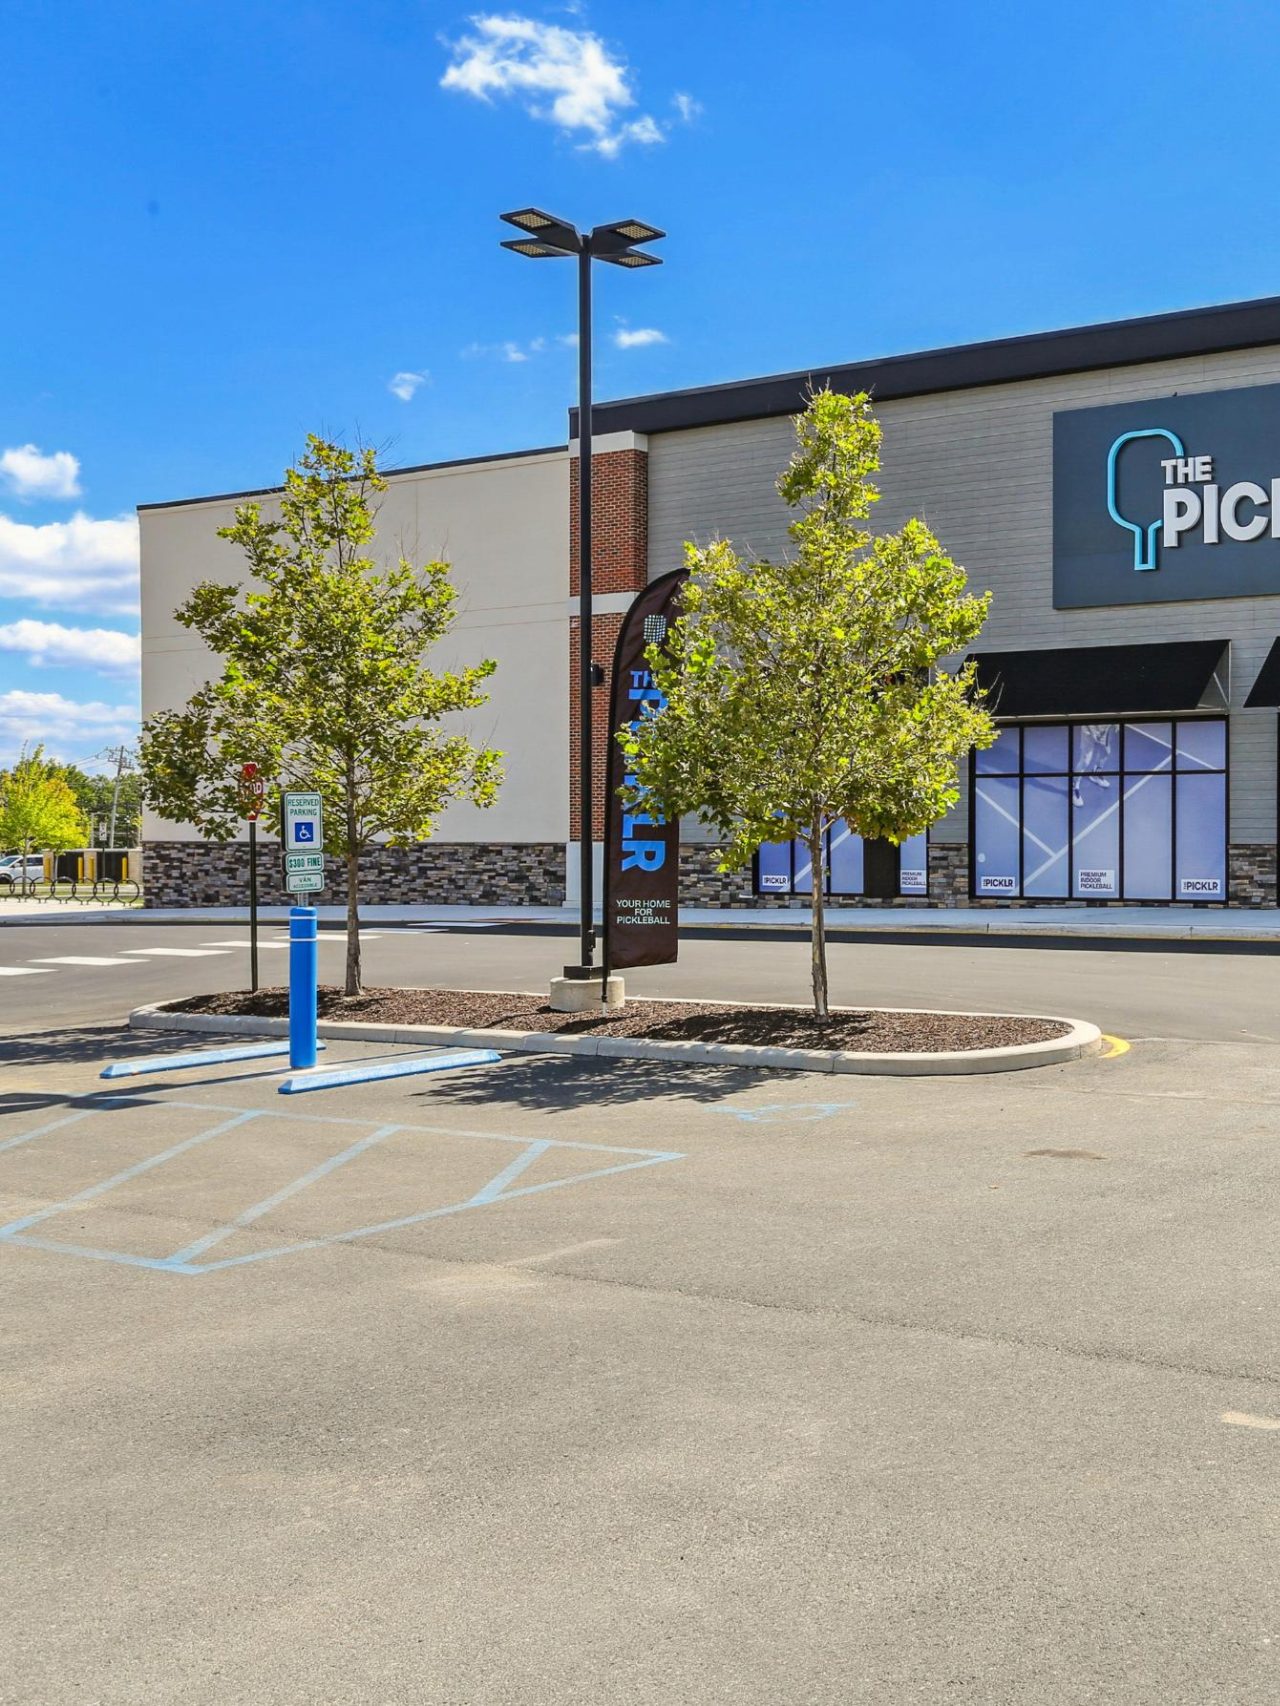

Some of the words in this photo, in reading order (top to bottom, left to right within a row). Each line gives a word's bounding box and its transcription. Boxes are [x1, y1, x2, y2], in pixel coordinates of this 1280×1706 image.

[1160, 455, 1213, 485] THE
[306, 856, 321, 867] FINE
[985, 878, 1014, 888] PICKLR
[1186, 881, 1219, 891] PICKLR
[616, 899, 642, 908] YOUR
[642, 899, 671, 908] HOME
[634, 908, 653, 916] FOR
[616, 916, 671, 925] PICKLEBALL
